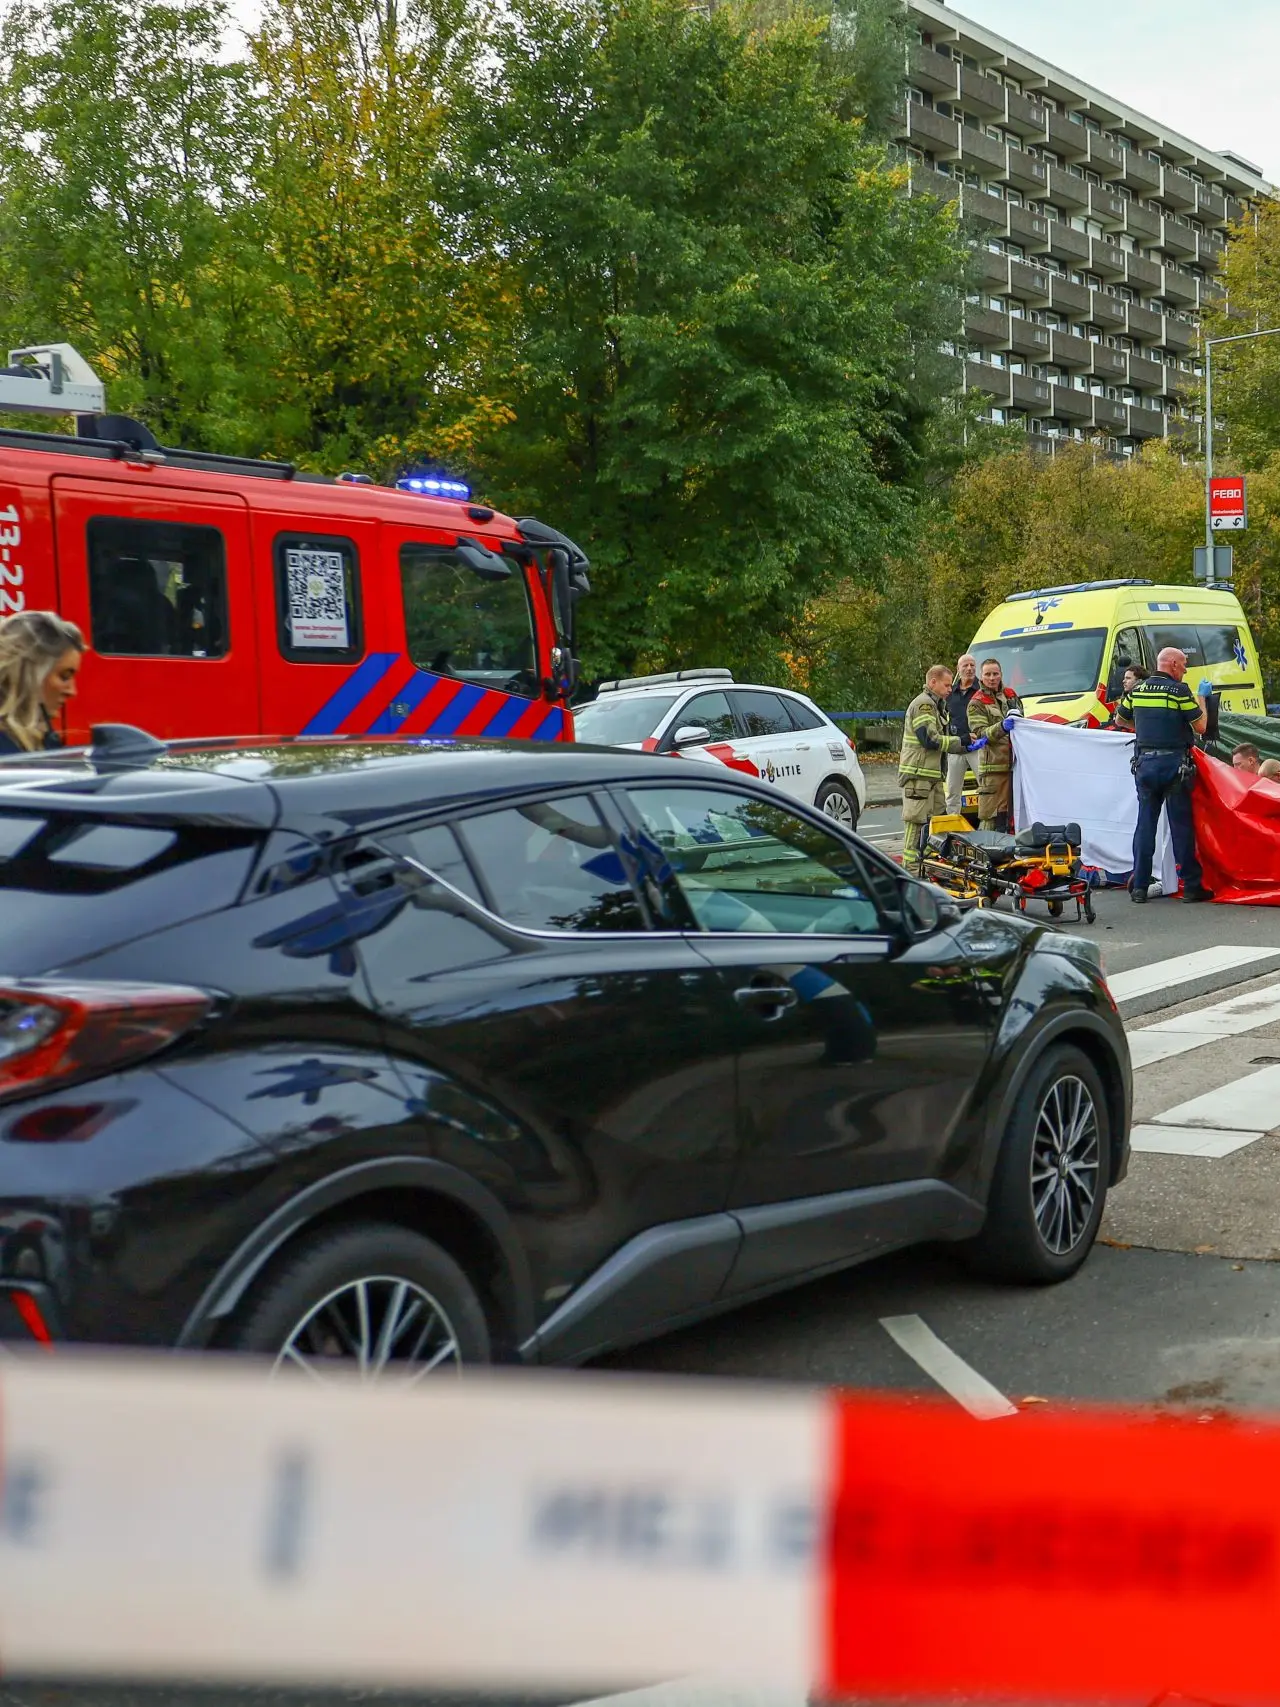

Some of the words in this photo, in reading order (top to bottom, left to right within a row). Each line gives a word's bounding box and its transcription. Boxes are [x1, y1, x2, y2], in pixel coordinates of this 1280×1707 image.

[1212, 489, 1242, 499] FEBO
[0, 504, 26, 622] 13-22
[761, 763, 801, 783] POLITIE
